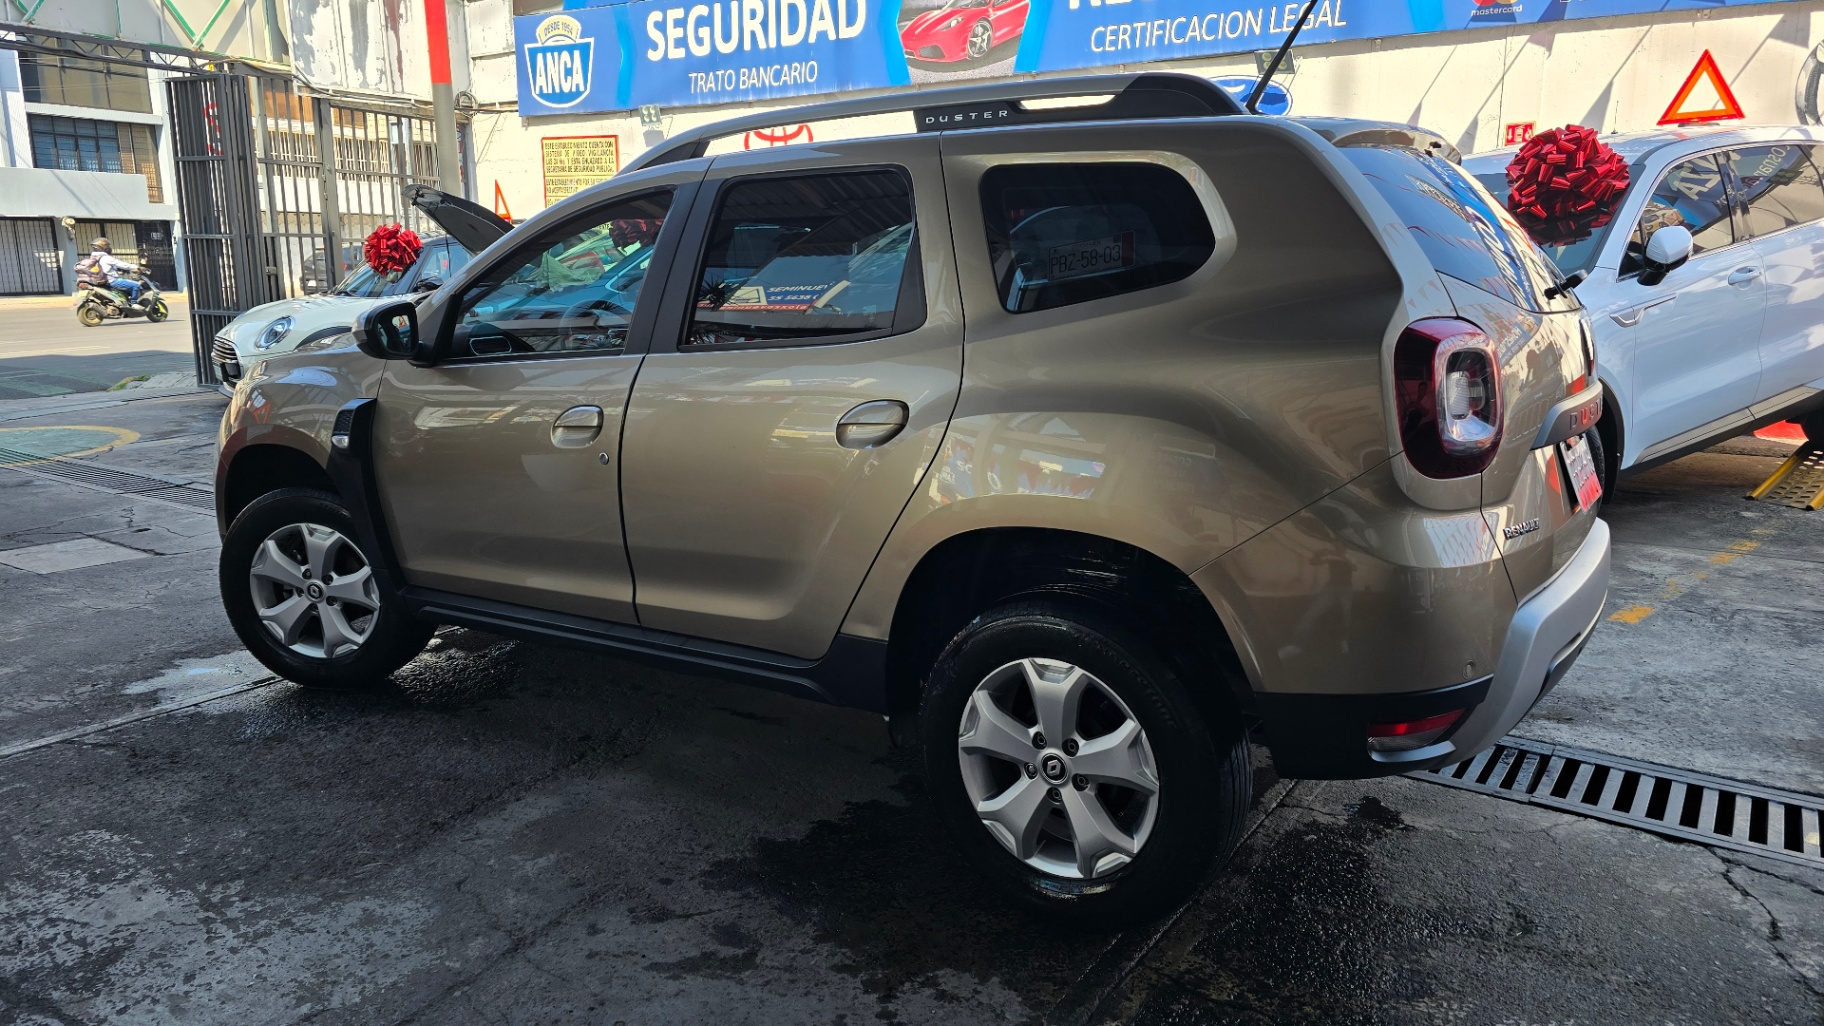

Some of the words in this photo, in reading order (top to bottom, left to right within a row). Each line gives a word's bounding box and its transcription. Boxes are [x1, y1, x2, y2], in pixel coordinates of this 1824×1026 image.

[1470, 4, 1523, 17] mastercard
[543, 20, 560, 37] DESDE
[646, 0, 867, 61] SEGURIDAD
[1090, 8, 1263, 53] CERTIFICACION
[1269, 0, 1347, 34] LEGAL
[535, 49, 585, 95] ANCA
[688, 69, 736, 94] TRATO
[739, 60, 818, 90] BANCARIO
[925, 110, 1008, 124] DUSTER
[1050, 244, 1121, 275] PBZ-58-03
[1503, 518, 1540, 540] RENAULT
